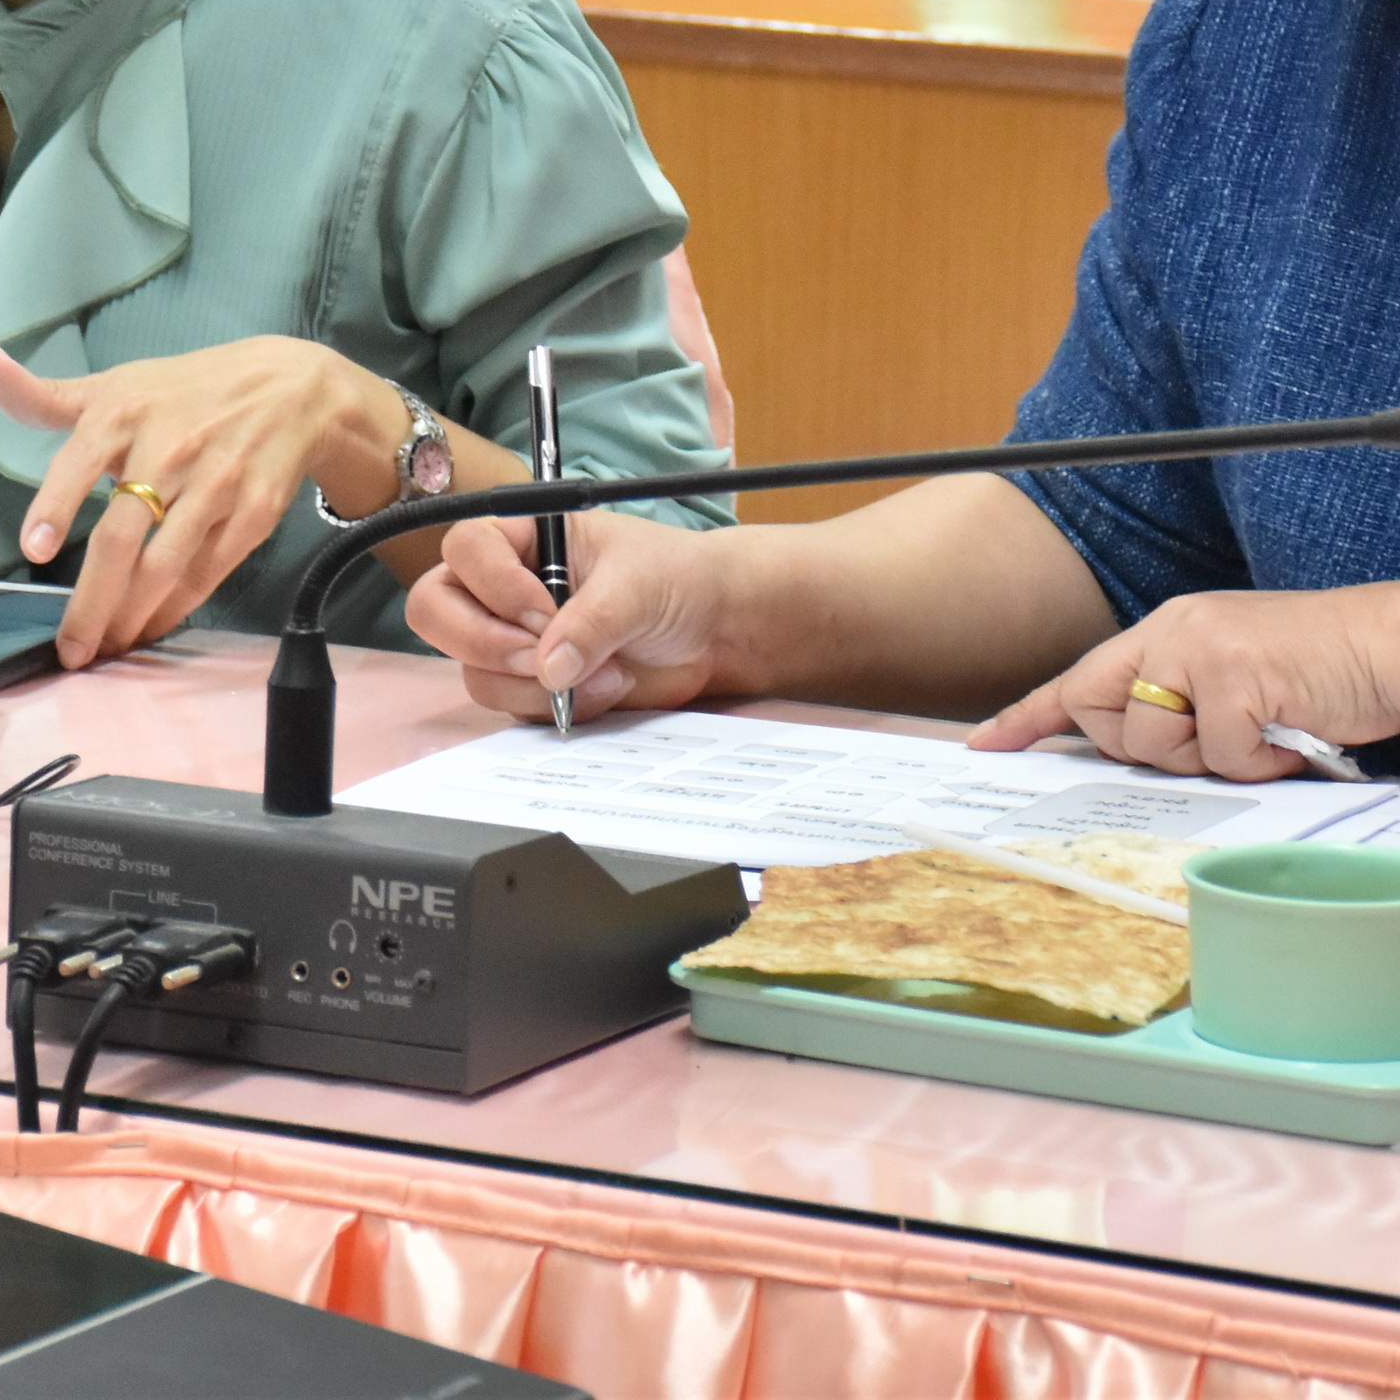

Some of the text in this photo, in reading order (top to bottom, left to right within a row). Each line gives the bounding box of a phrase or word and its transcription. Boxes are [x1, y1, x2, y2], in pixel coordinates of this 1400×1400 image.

[28, 831, 123, 856] PROFESSIONAL
[28, 847, 171, 878] CONFERENCE SYSTEM
[148, 889, 181, 907] LINE
[351, 874, 456, 920] NPE
[351, 904, 456, 930] RESEARCH
[287, 989, 313, 1004] REC
[320, 994, 361, 1012] PHONE
[363, 990, 413, 1008] VOLUME
